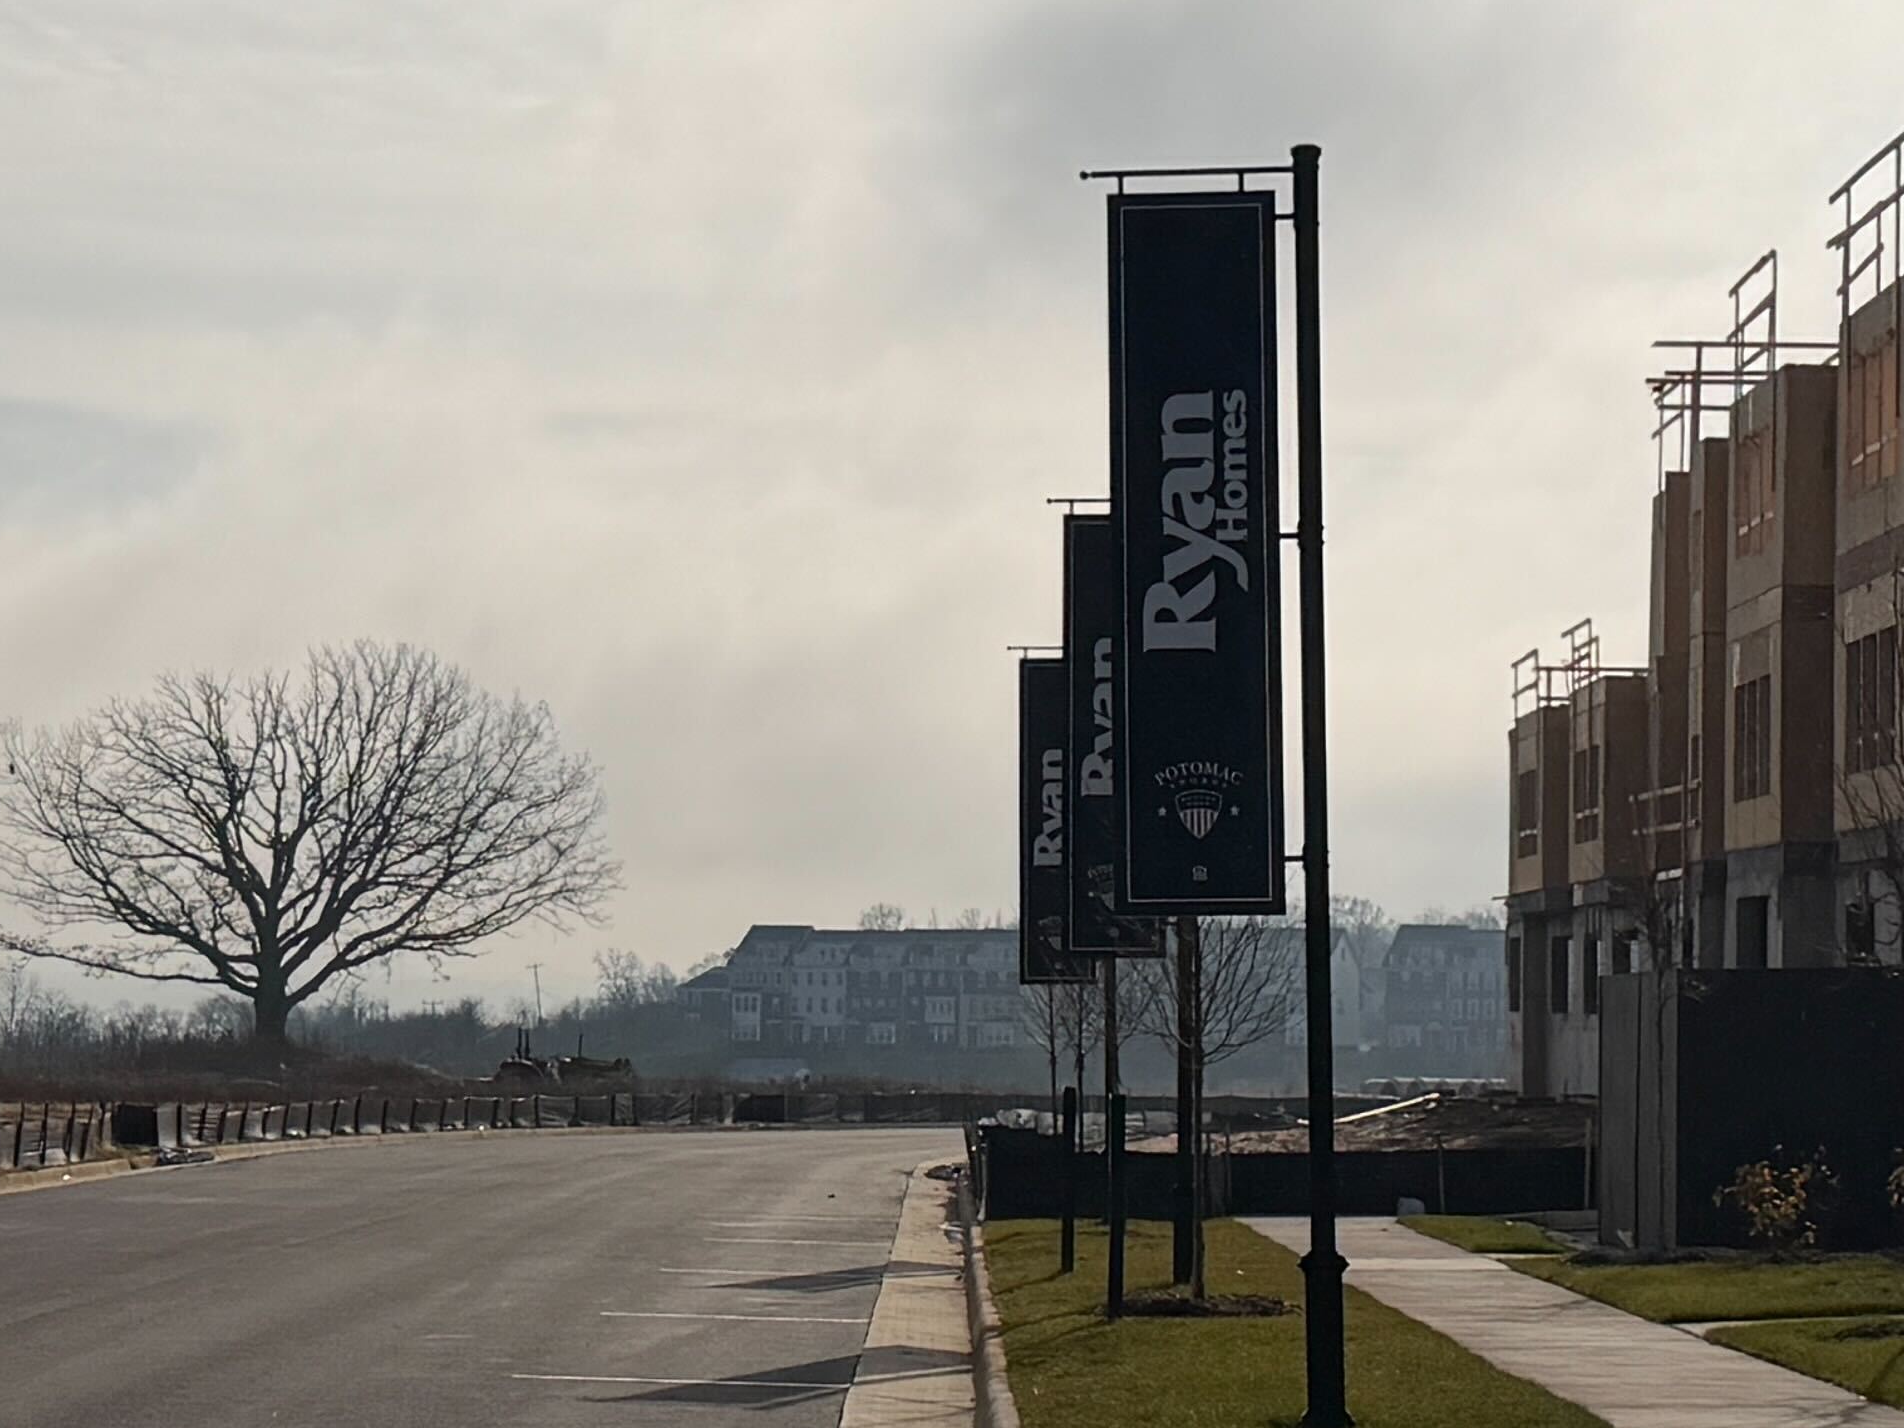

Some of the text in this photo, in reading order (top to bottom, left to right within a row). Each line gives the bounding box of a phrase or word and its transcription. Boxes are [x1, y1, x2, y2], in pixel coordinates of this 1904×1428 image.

[1143, 390, 1249, 653] Ryan
[1216, 388, 1248, 542] Homes
[1154, 761, 1244, 786] POTOMAC
